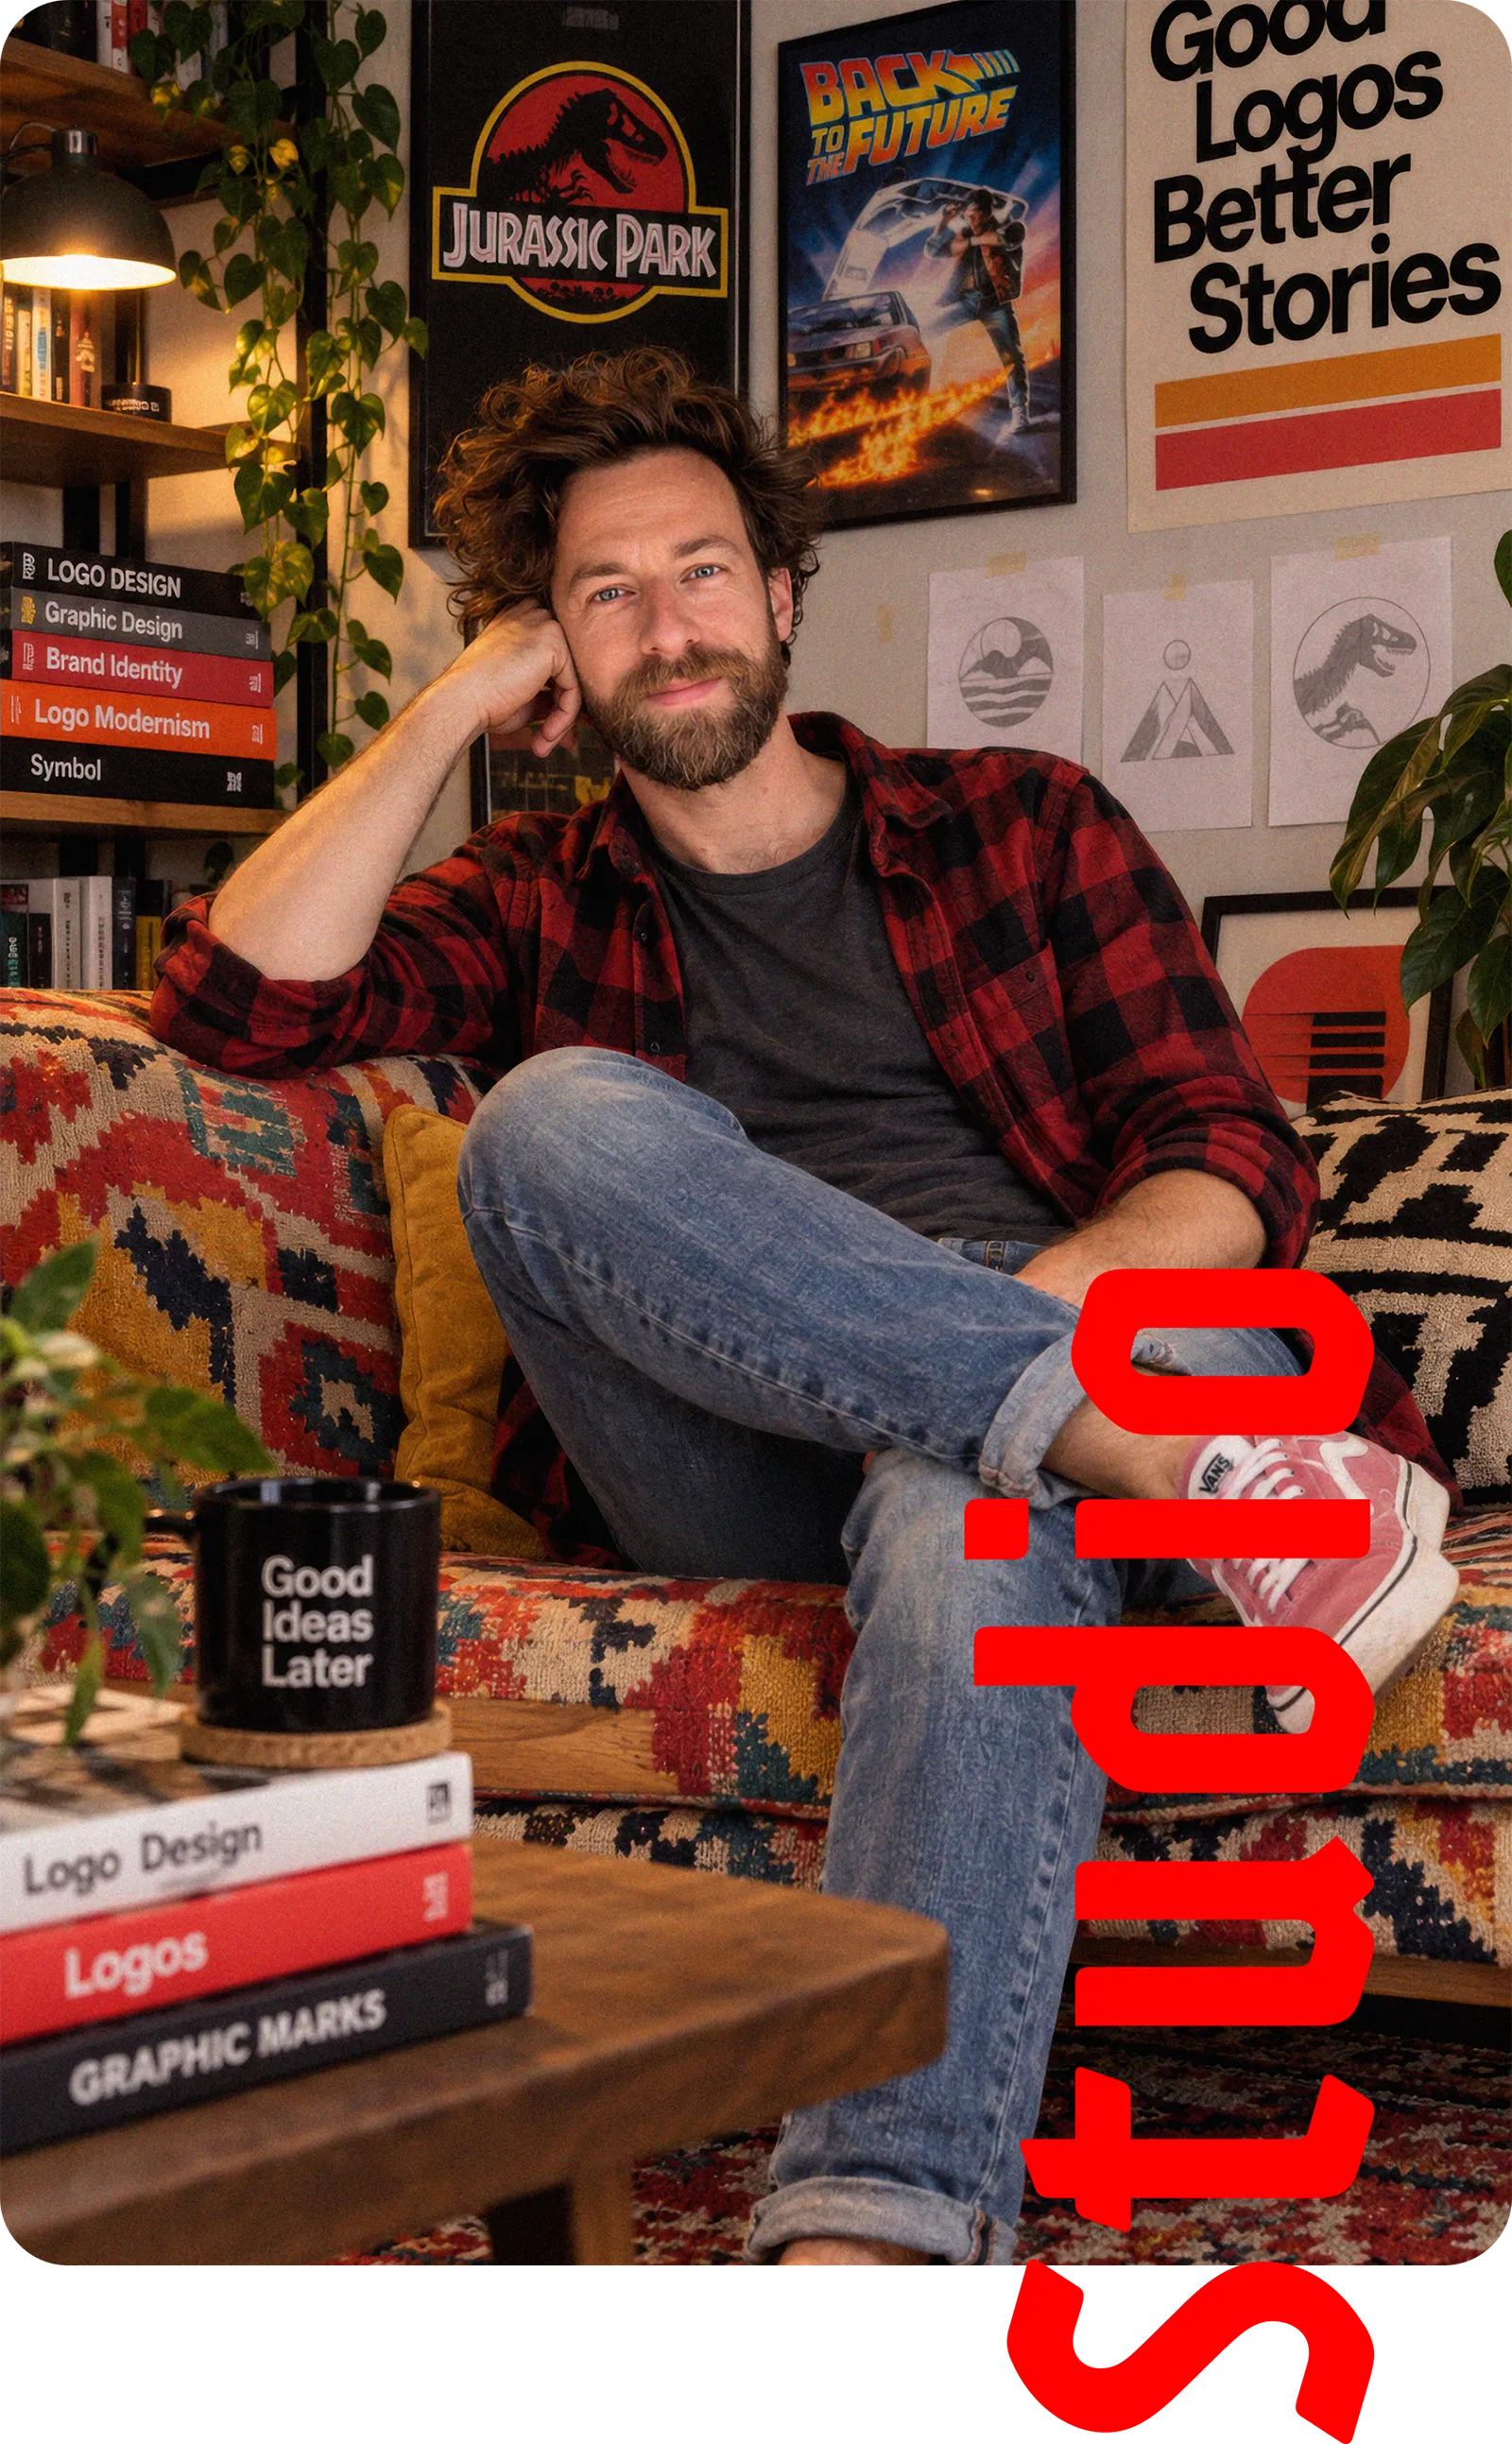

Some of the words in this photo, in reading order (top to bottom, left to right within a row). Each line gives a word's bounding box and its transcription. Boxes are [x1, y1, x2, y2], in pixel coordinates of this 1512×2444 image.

[799, 49, 988, 127] BACK
[1195, 50, 1444, 164] Logos
[811, 124, 844, 156] TO
[844, 85, 1019, 176] FUTURE
[805, 153, 847, 186] THE
[1154, 147, 1412, 264] Better
[442, 201, 609, 271] JURASSIC
[615, 214, 716, 278] PARK
[1188, 232, 1502, 354] Stories
[47, 558, 106, 587] LOGO
[111, 567, 181, 598] DESIGN
[44, 601, 117, 631] Graphic
[122, 611, 183, 643] Design
[46, 646, 105, 676] Brand
[111, 654, 183, 690] Identity
[35, 698, 90, 732] Logo
[94, 704, 211, 740] Modernism
[30, 752, 101, 783] Symbol
[1198, 1453, 1233, 1494] VANS
[262, 1554, 373, 1598] Good
[263, 1600, 374, 1643] Ideas
[262, 1645, 373, 1688] Later
[23, 1850, 122, 1898] Logo
[141, 1821, 263, 1873] Design
[64, 1931, 209, 1998] Logos
[69, 2022, 253, 2107] GRAPHIC
[257, 1988, 387, 2057] MARKS
